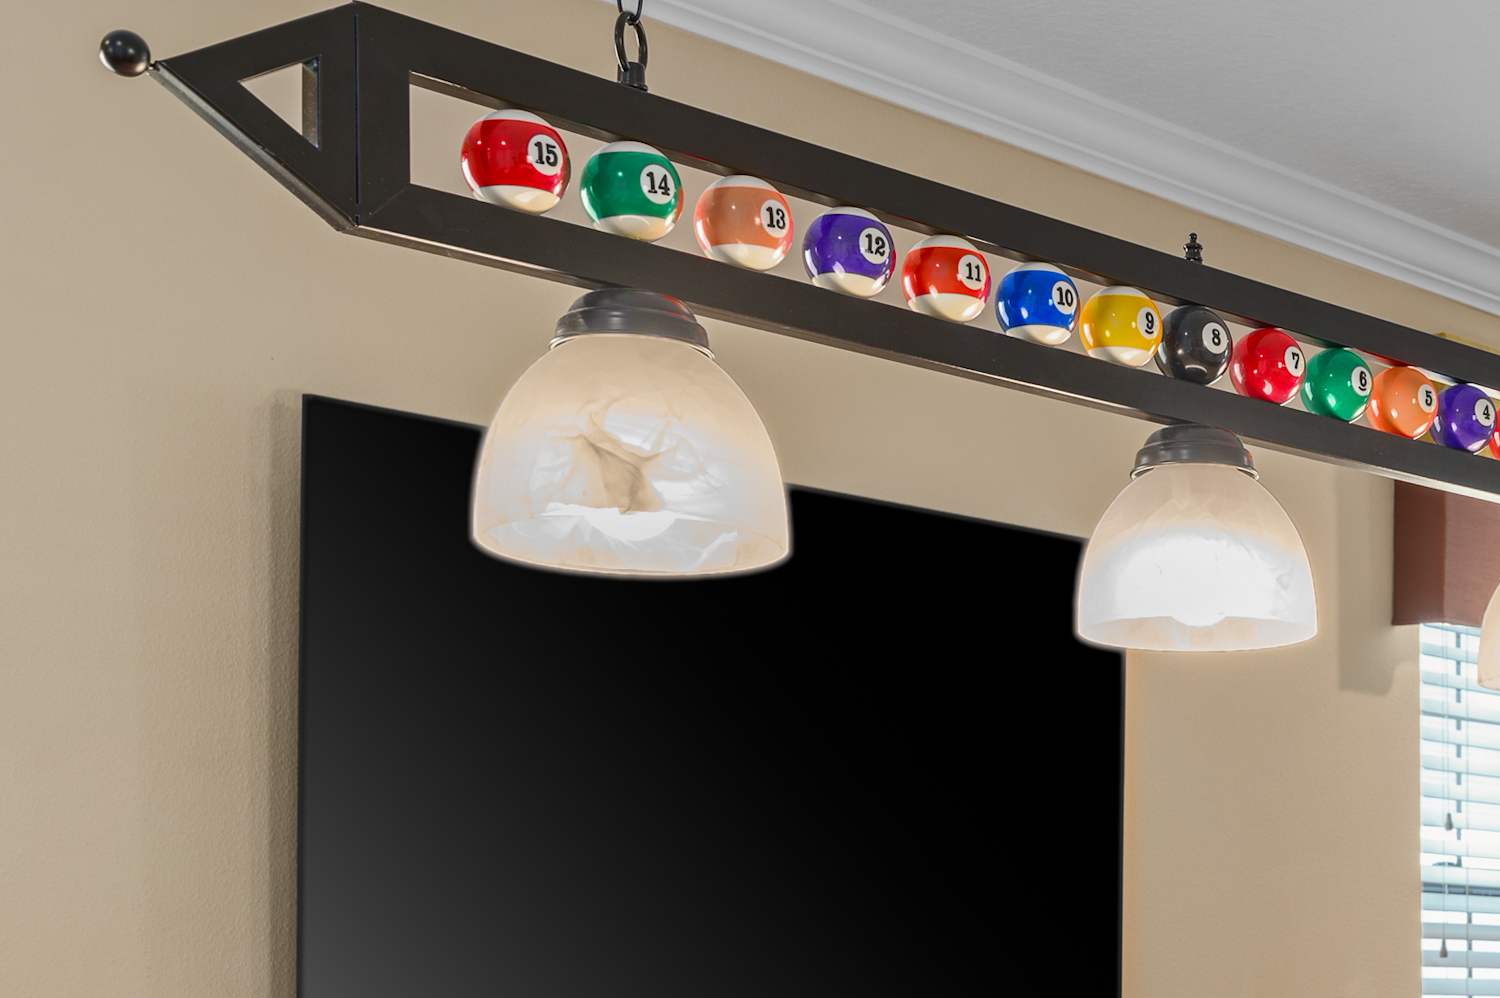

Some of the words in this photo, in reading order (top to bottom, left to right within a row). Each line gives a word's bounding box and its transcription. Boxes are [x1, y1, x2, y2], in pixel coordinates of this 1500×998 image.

[533, 141, 558, 167] 15
[645, 171, 671, 196] 14
[766, 206, 786, 230] 13
[864, 233, 886, 257] 12
[965, 262, 982, 283] 11
[1056, 286, 1074, 308] 10
[1144, 311, 1154, 335] 9
[1212, 328, 1221, 347] 8
[1291, 352, 1300, 369] 7
[1359, 371, 1367, 391] 6
[1425, 390, 1432, 406] 5
[1482, 405, 1490, 420] 4
